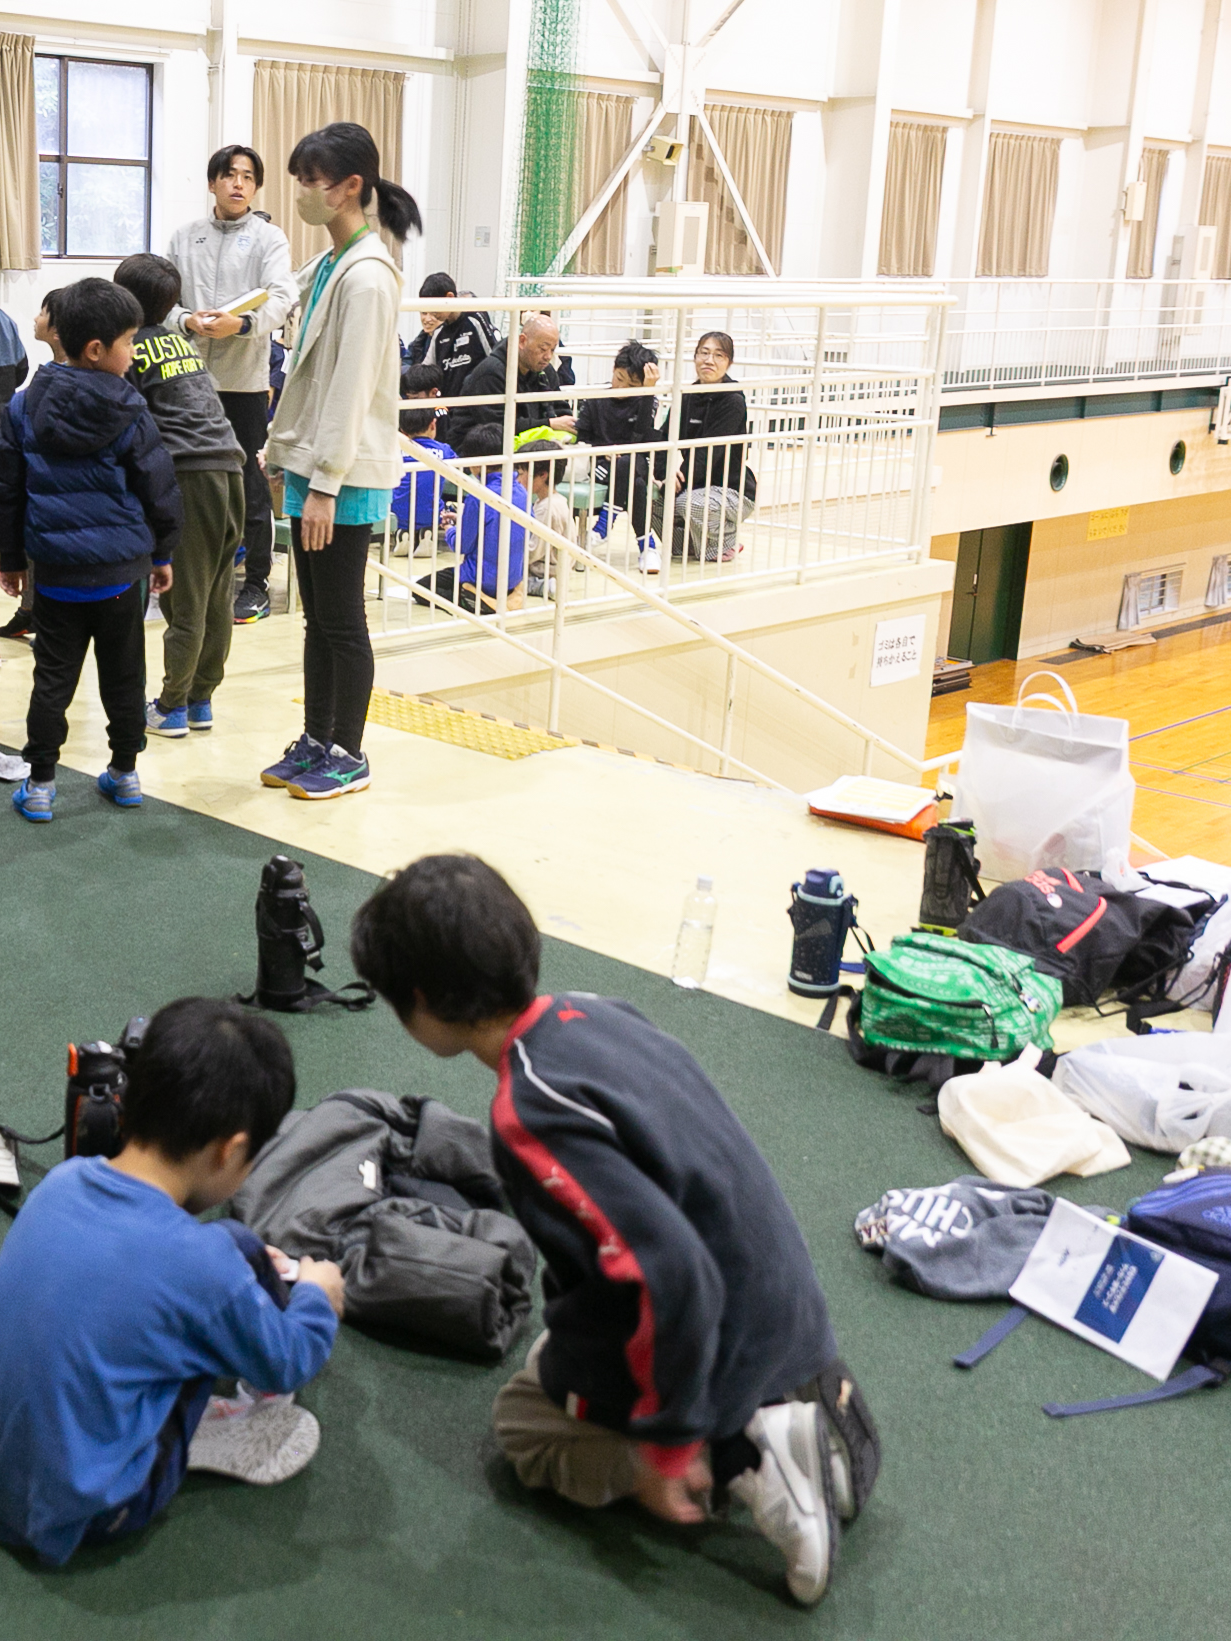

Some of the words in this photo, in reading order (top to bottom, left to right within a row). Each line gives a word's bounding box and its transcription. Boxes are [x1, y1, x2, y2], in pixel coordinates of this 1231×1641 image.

[133, 334, 198, 373] SUSTA
[161, 360, 184, 380] HOPE
[877, 635, 916, 651] ゴミは各自で
